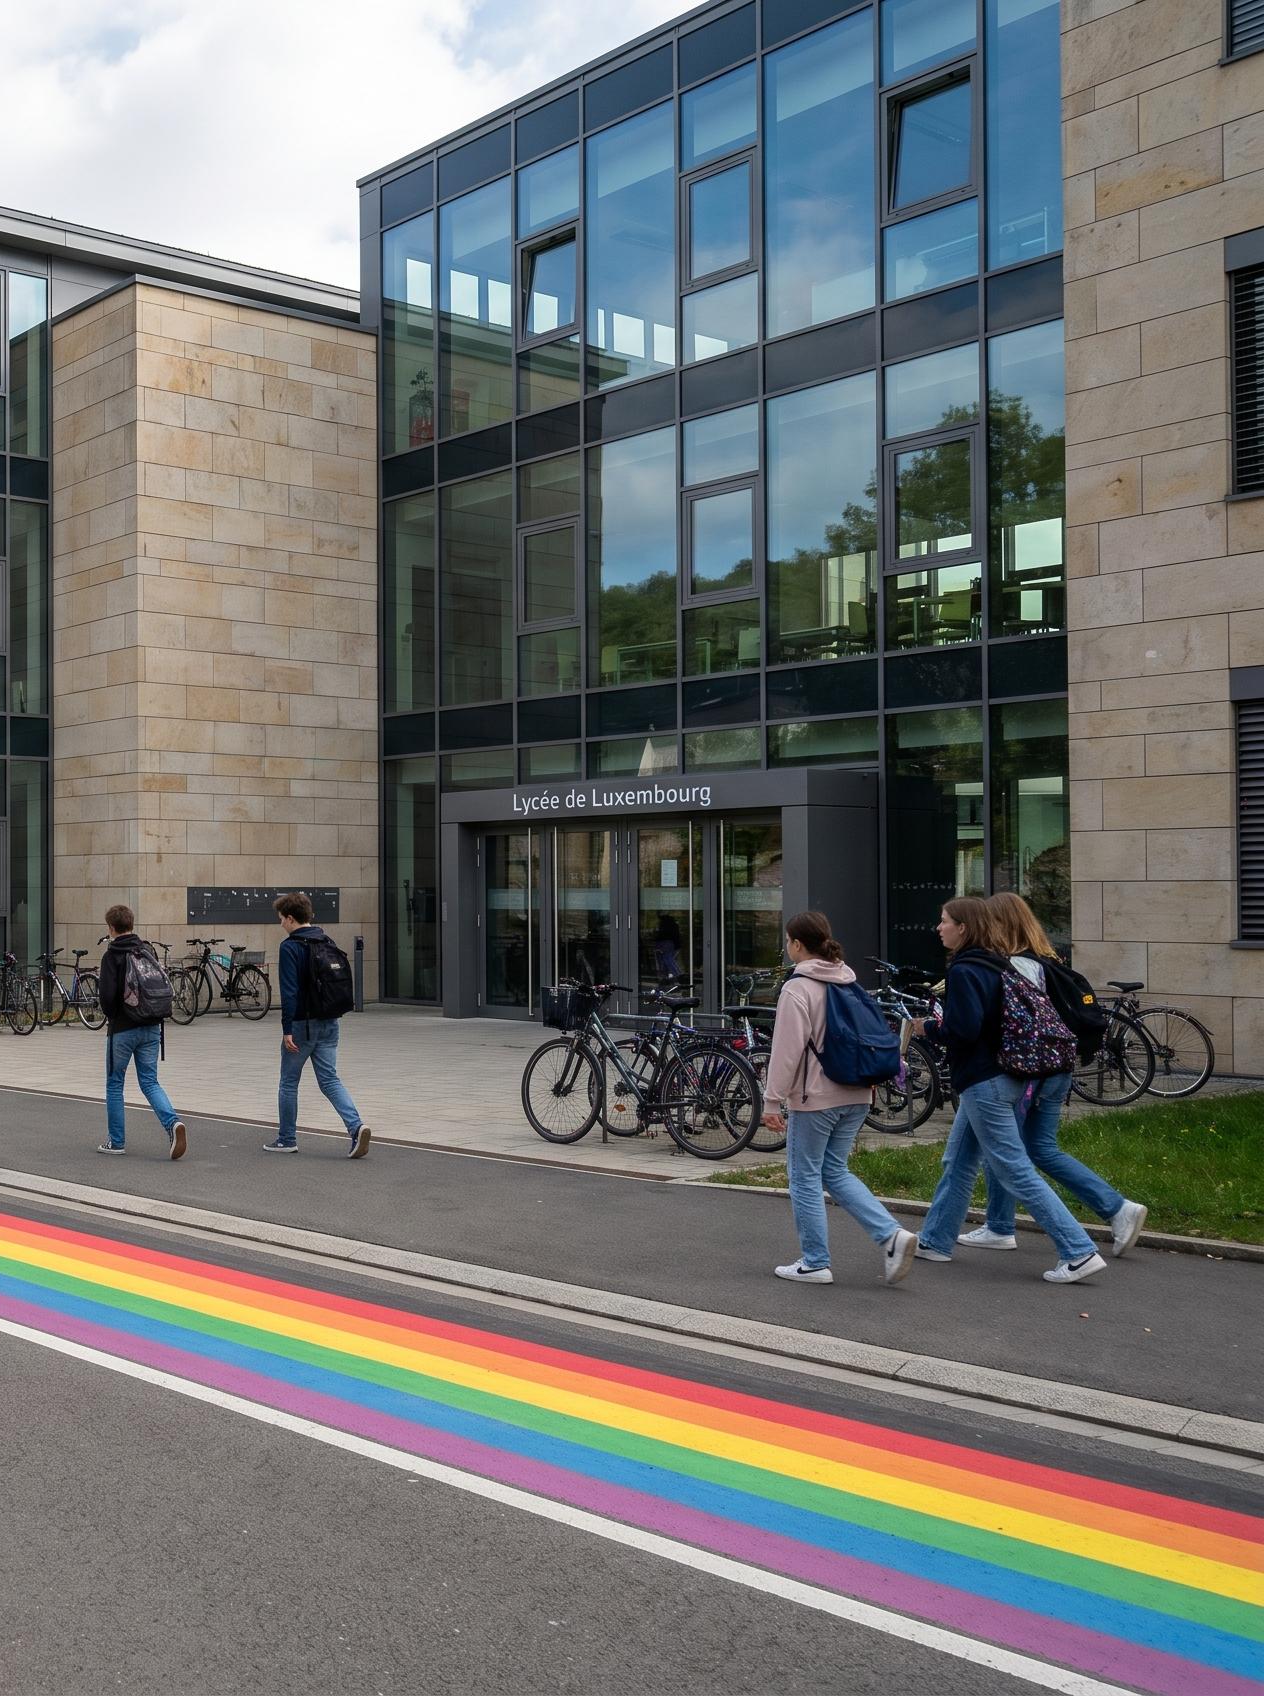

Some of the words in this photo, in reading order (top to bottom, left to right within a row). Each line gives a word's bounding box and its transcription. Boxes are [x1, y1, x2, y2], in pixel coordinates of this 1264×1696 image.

[513, 789, 560, 816] Lycée
[565, 788, 586, 809] de
[592, 783, 711, 807] Luxembourg
